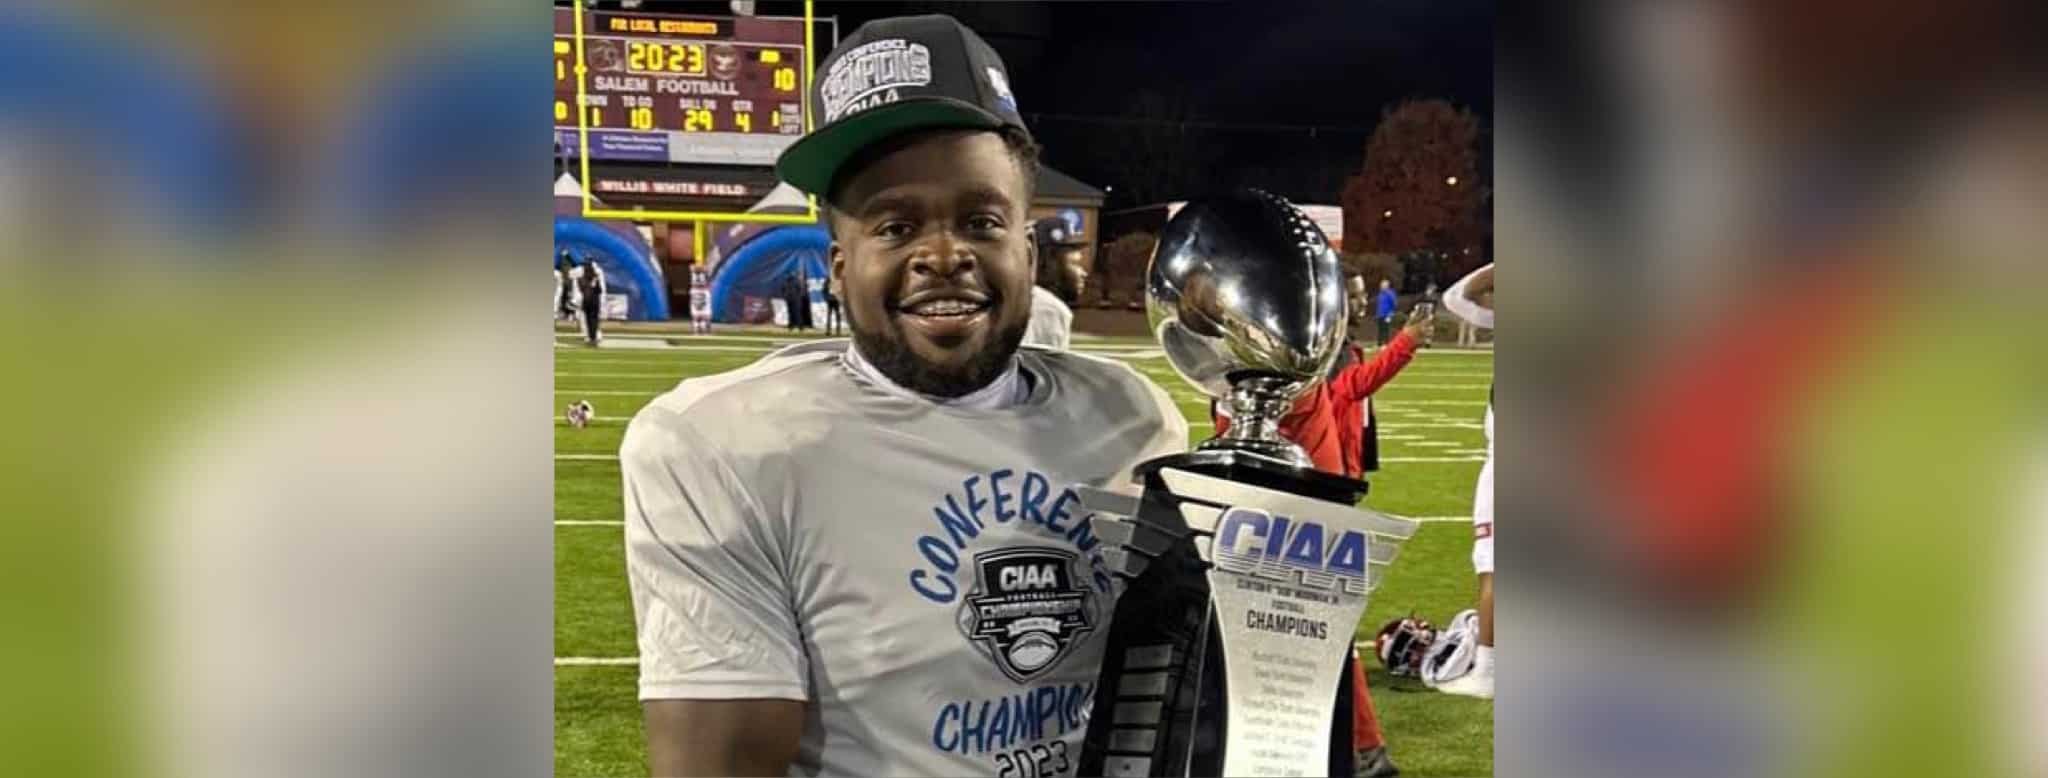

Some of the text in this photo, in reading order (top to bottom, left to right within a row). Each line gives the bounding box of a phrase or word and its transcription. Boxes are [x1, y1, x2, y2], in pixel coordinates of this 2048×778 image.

[630, 43, 704, 72] 20:23
[594, 76, 740, 96] SALEM FOOTBALL
[774, 67, 796, 91] 10
[630, 107, 654, 130] 10
[684, 109, 714, 132] 29
[735, 112, 751, 133] 4
[600, 180, 745, 195] WILLIS WHITE FIELD
[1216, 508, 1369, 594] CIAA
[1000, 564, 1058, 592] CIAA
[1246, 609, 1329, 640] CHAMPIONS
